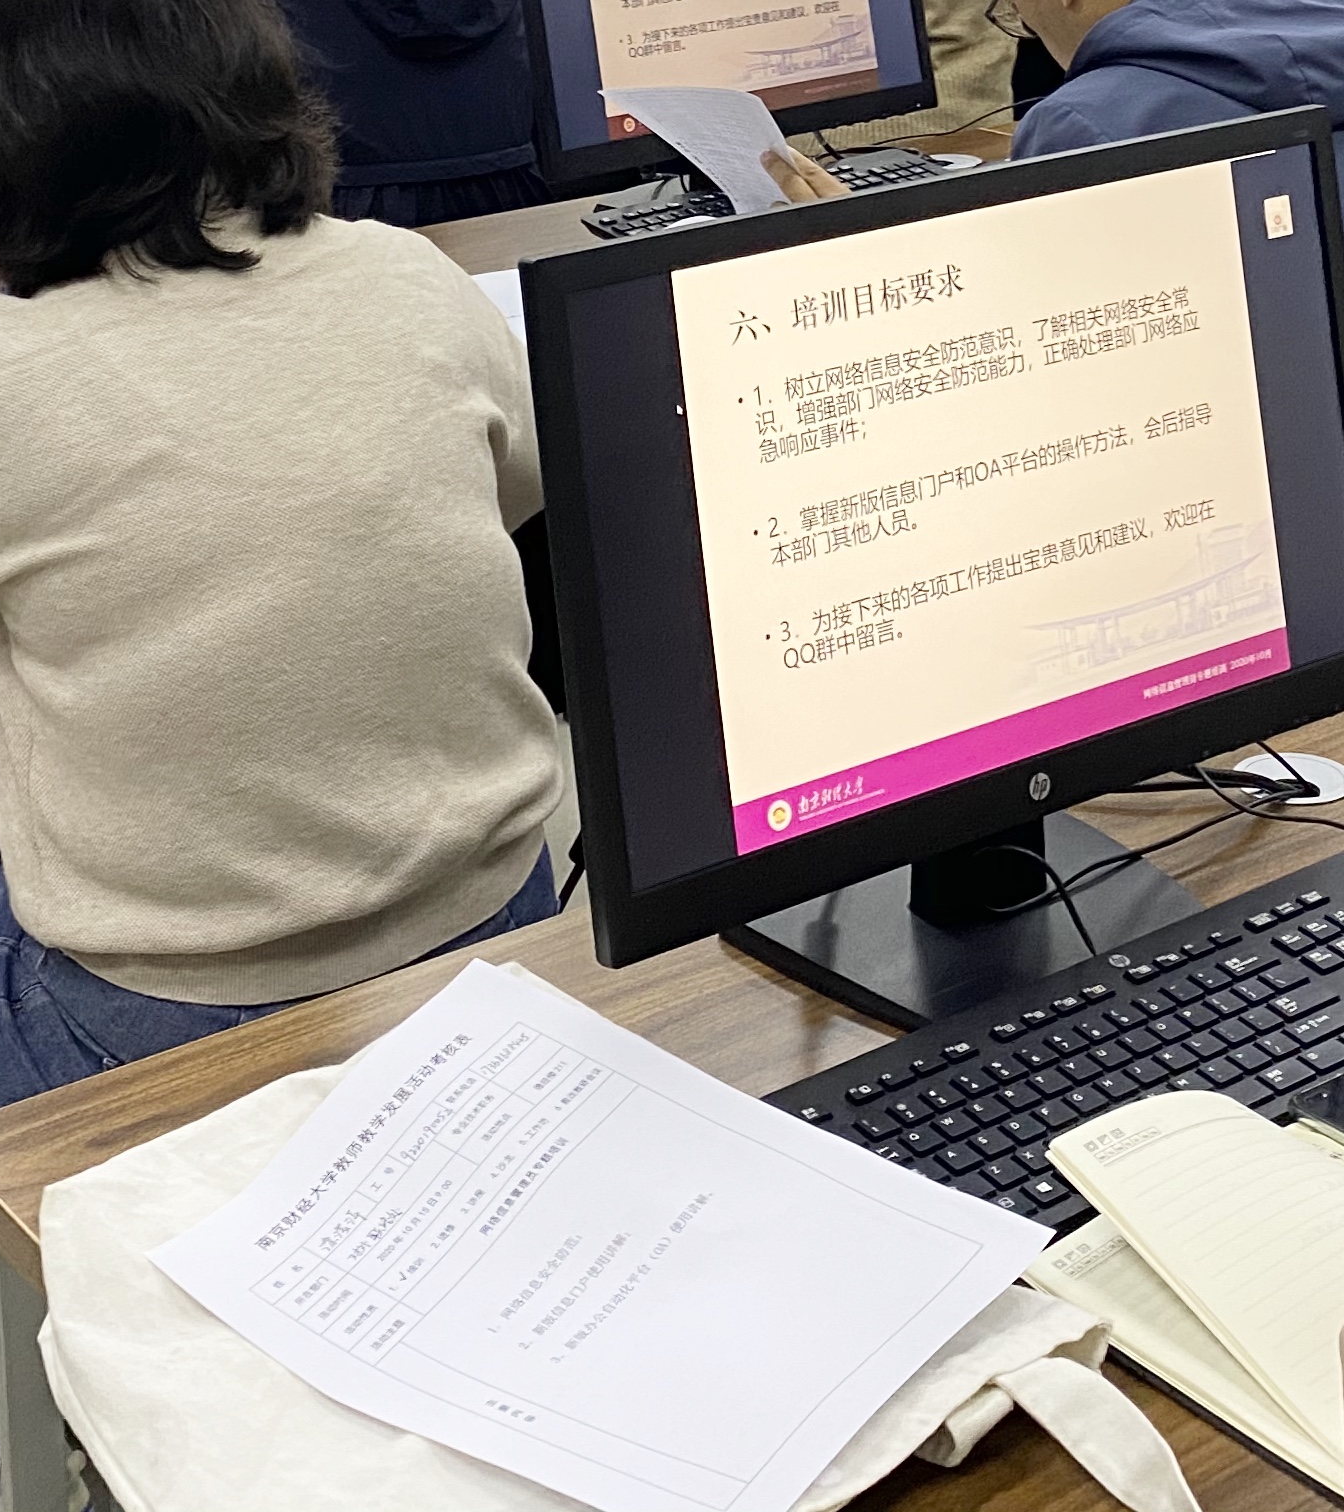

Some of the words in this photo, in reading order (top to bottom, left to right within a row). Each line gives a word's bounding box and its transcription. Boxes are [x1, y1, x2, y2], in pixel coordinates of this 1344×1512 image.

[728, 264, 965, 346] 六、培训目标要求
[759, 419, 868, 463] 急响应事件；
[770, 512, 920, 567] 本部门其他人员。
[783, 626, 905, 669] QQ群中留言。
[1030, 772, 1050, 800] hp
[255, 1032, 473, 1251] 南京财经大学教师教学发展活动考核表
